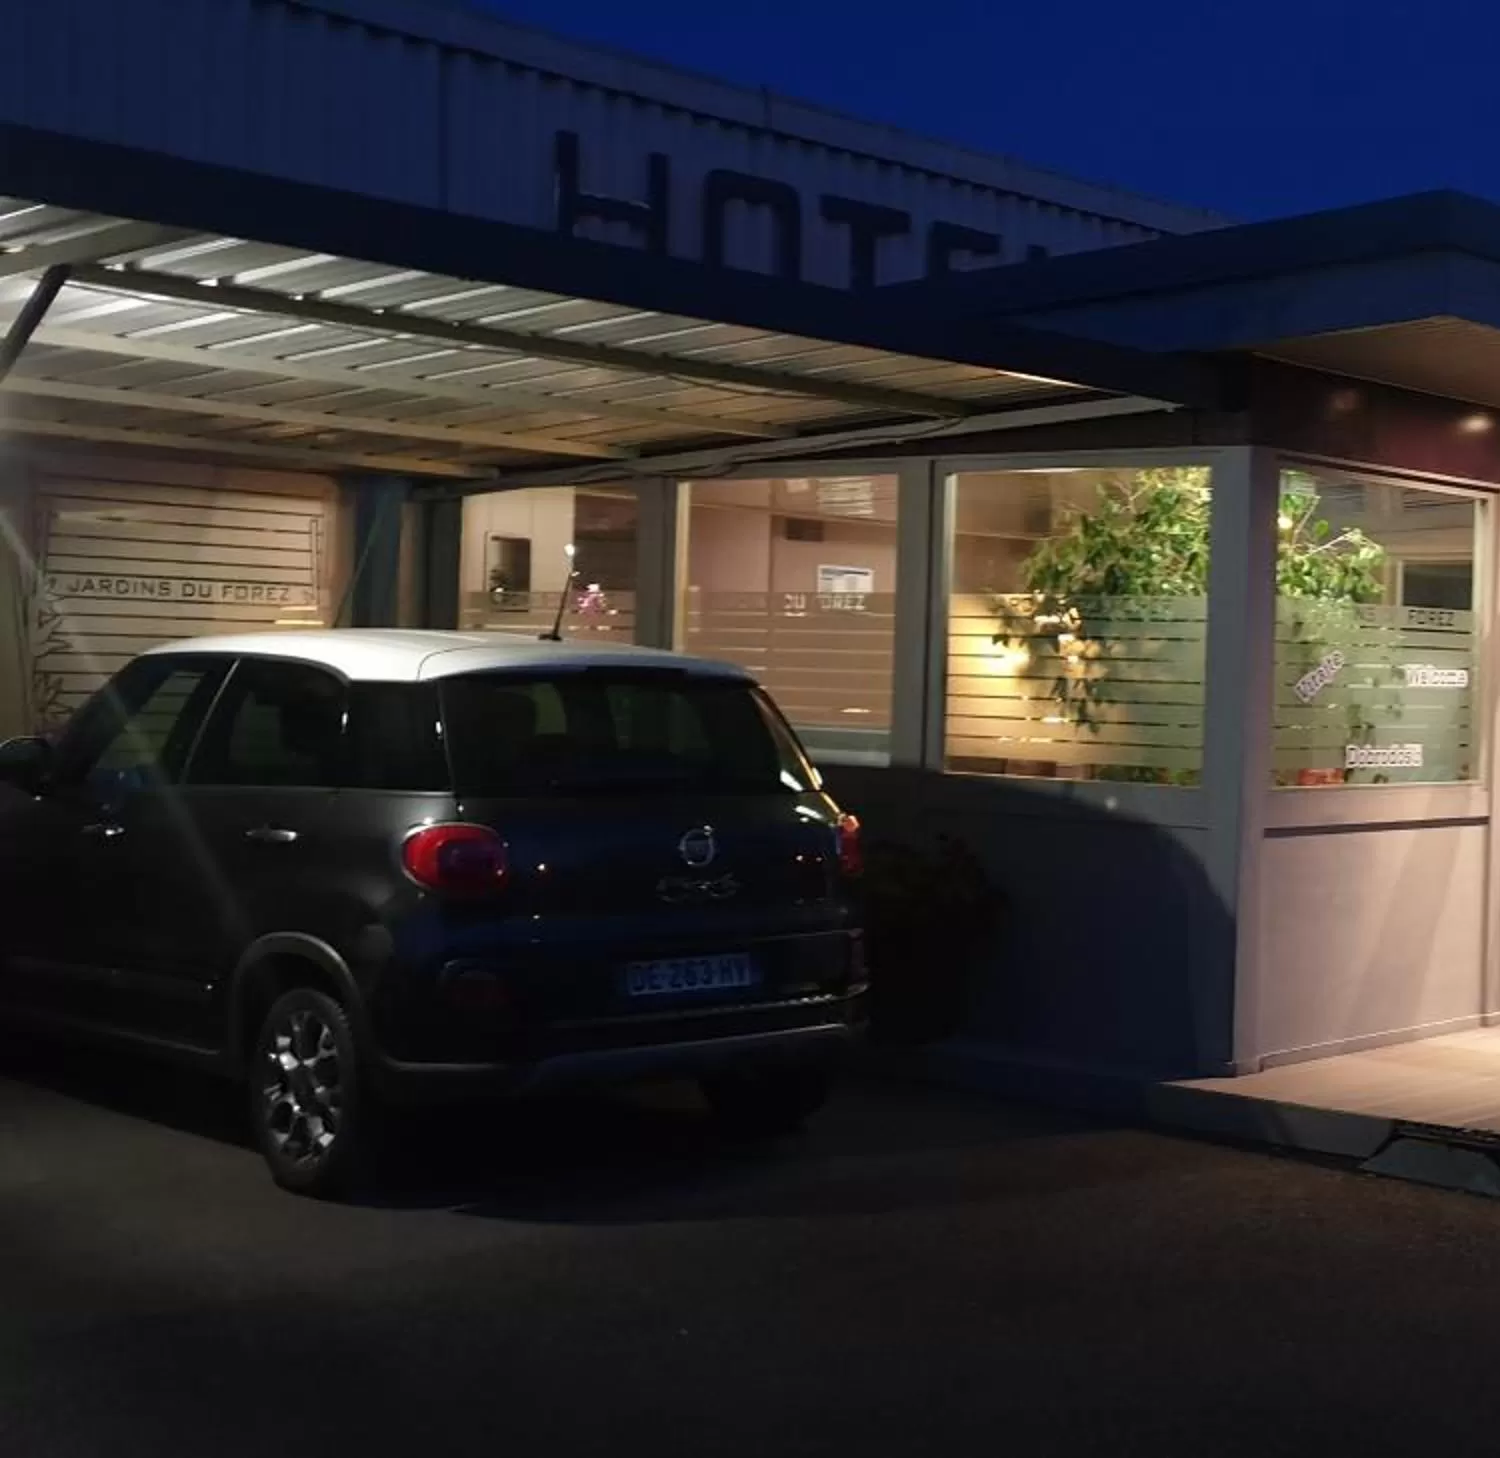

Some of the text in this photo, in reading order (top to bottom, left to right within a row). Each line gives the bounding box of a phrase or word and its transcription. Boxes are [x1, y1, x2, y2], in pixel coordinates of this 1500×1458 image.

[68, 578, 289, 600] JARDINS DU FOREZ
